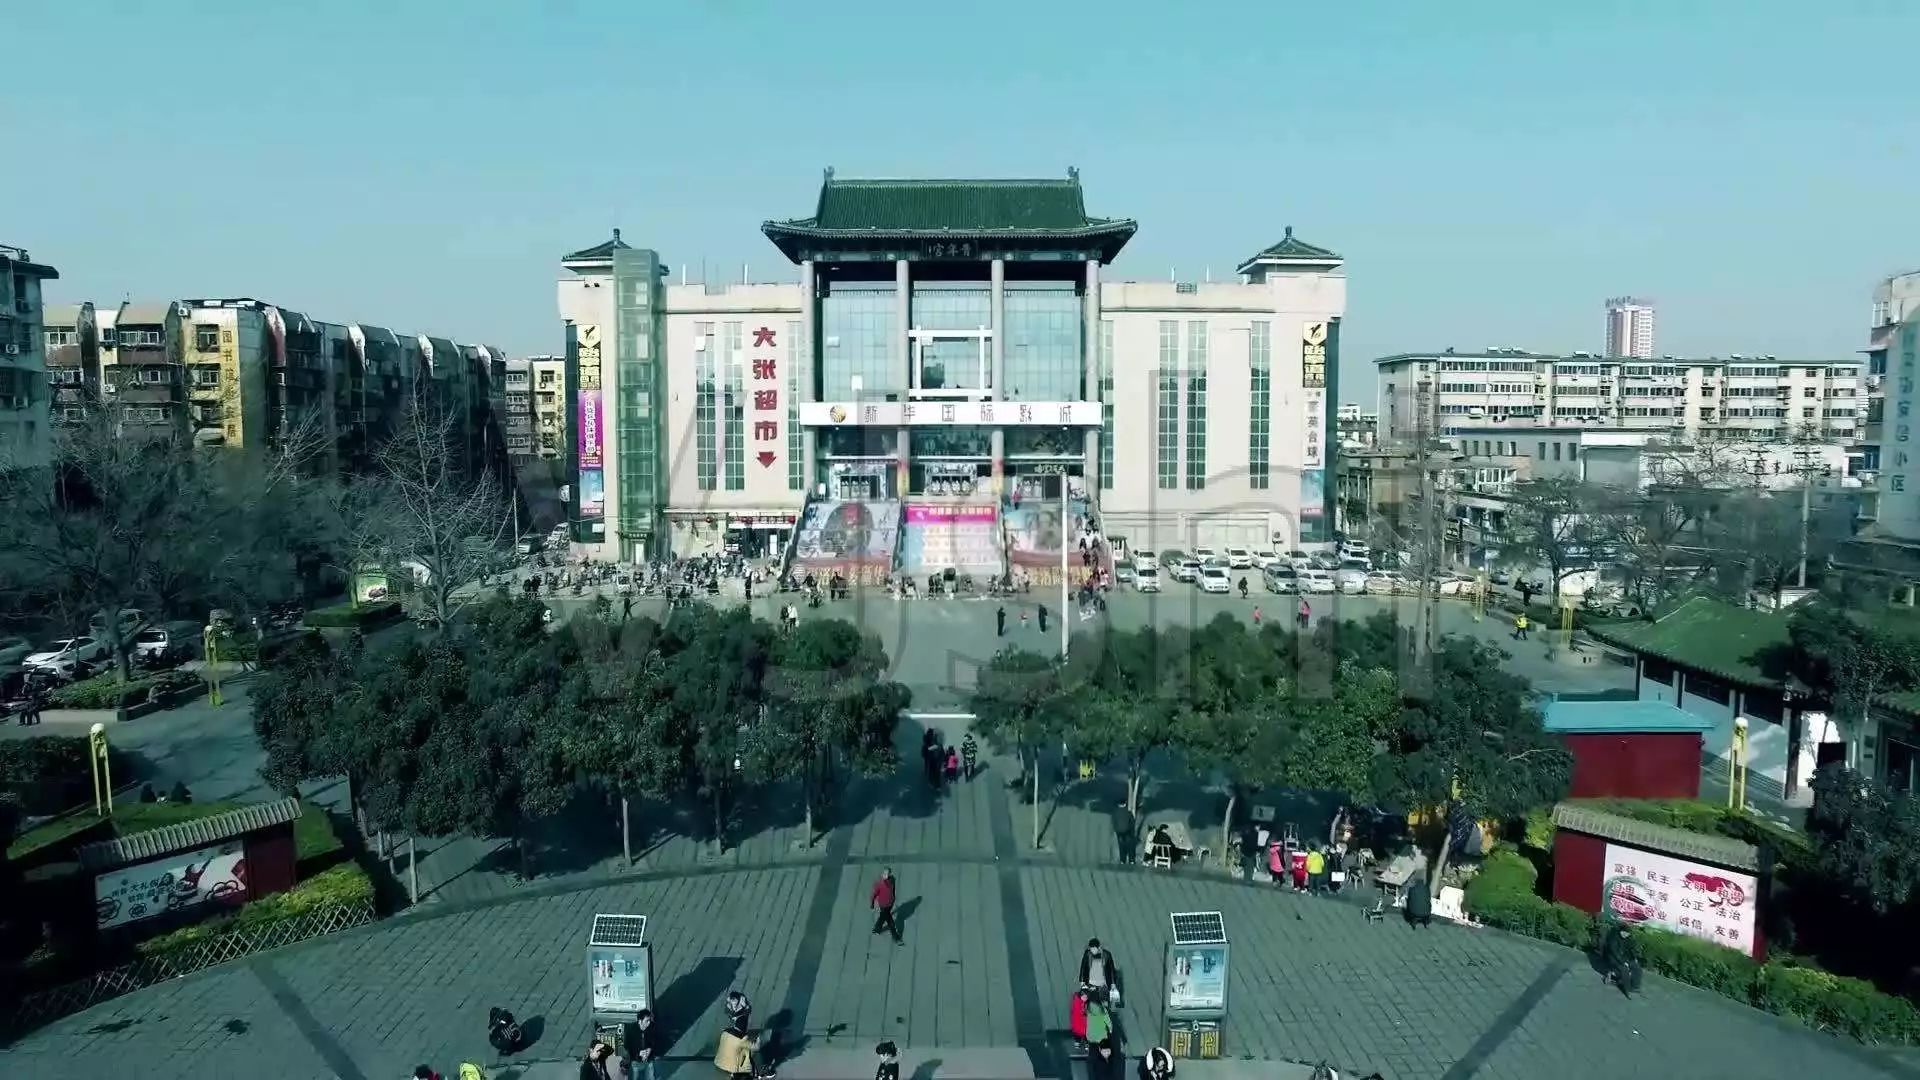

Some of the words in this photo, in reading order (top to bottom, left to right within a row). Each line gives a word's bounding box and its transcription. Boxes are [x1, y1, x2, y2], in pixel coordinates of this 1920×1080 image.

[752, 326, 777, 441] 大张超市
[864, 404, 1072, 424] 新华国际影城
[1613, 863, 1637, 875] 富强
[1647, 871, 1671, 885] 民主
[1680, 878, 1706, 893] 文明
[1646, 888, 1669, 903] 平等
[1680, 897, 1705, 912] 公正
[1715, 907, 1741, 922] 法治
[1679, 916, 1703, 930] 诚信
[1714, 925, 1740, 941] 友善
